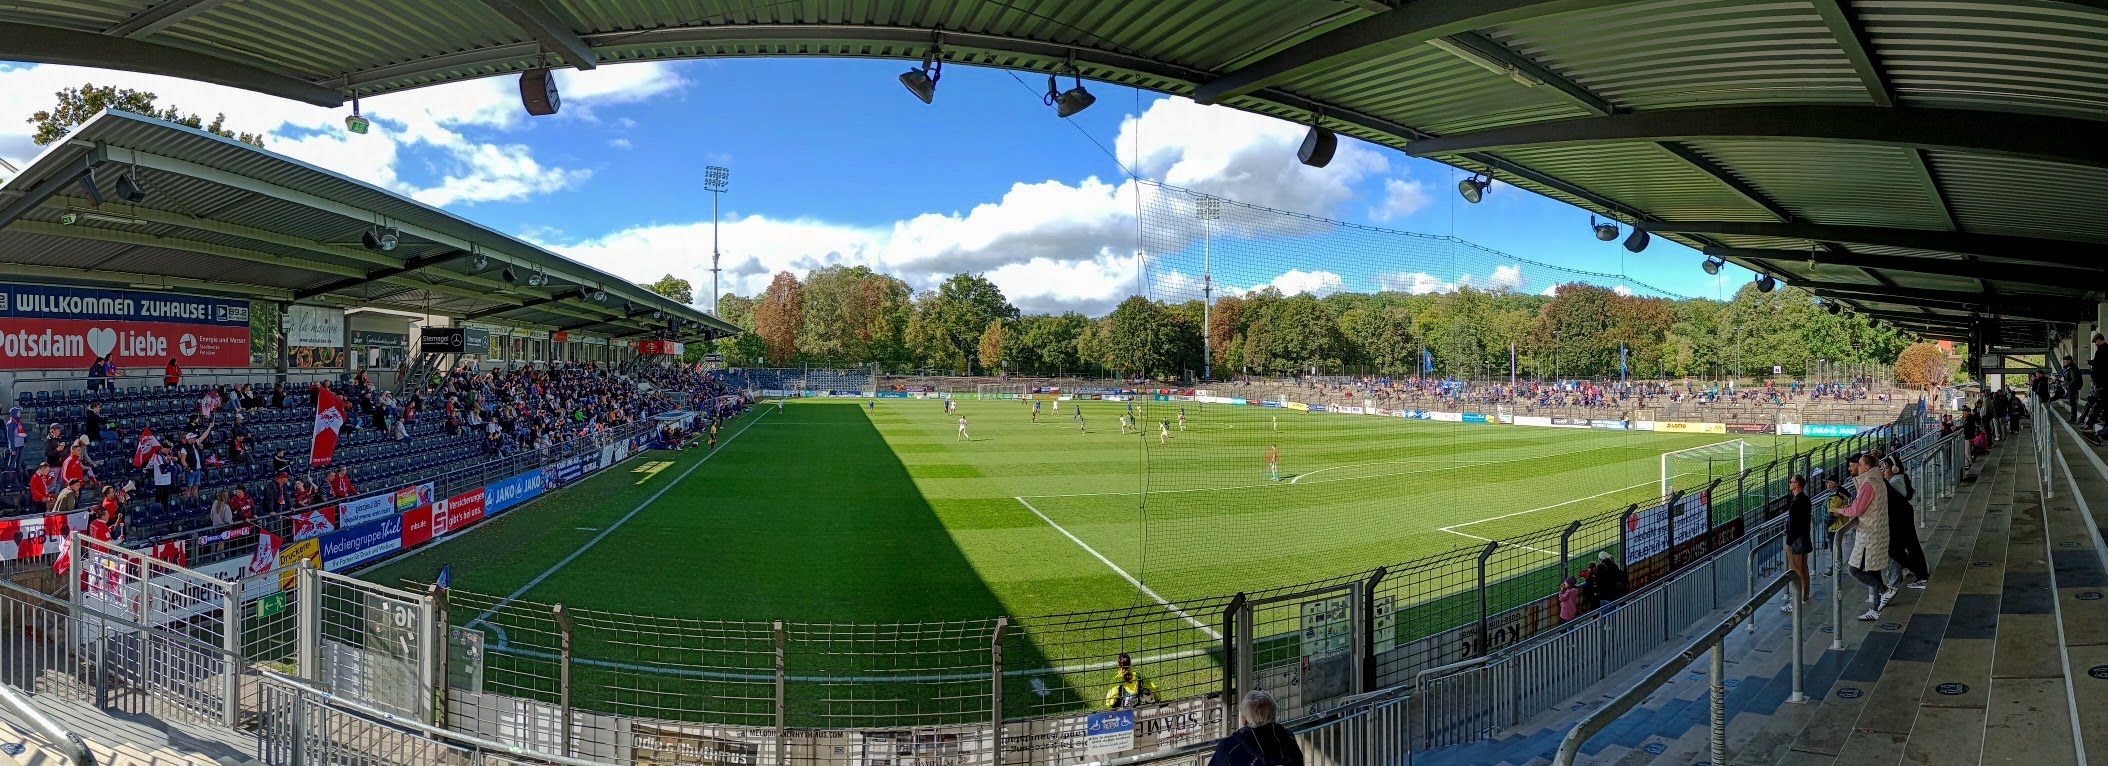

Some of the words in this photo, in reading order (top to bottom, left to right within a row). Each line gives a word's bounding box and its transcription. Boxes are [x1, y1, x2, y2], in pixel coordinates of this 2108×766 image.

[17, 294, 134, 315] WILLKOMMEN
[119, 330, 167, 357] Liebe
[496, 484, 515, 503] JAKO
[524, 476, 541, 493] JAKO
[449, 492, 485, 510] Versicherungen
[410, 520, 427, 531] mbs.de
[449, 512, 463, 527] gibt's
[463, 510, 471, 522] bei
[472, 507, 482, 517] uns.
[381, 517, 402, 539] Thiel
[280, 540, 311, 565] Druckerei
[323, 531, 382, 556] Mediengruppe
[360, 550, 371, 559] Druck
[749, 729, 843, 739] MELODINDRHYTHMUS.COM
[677, 742, 747, 764] Rhythmus
